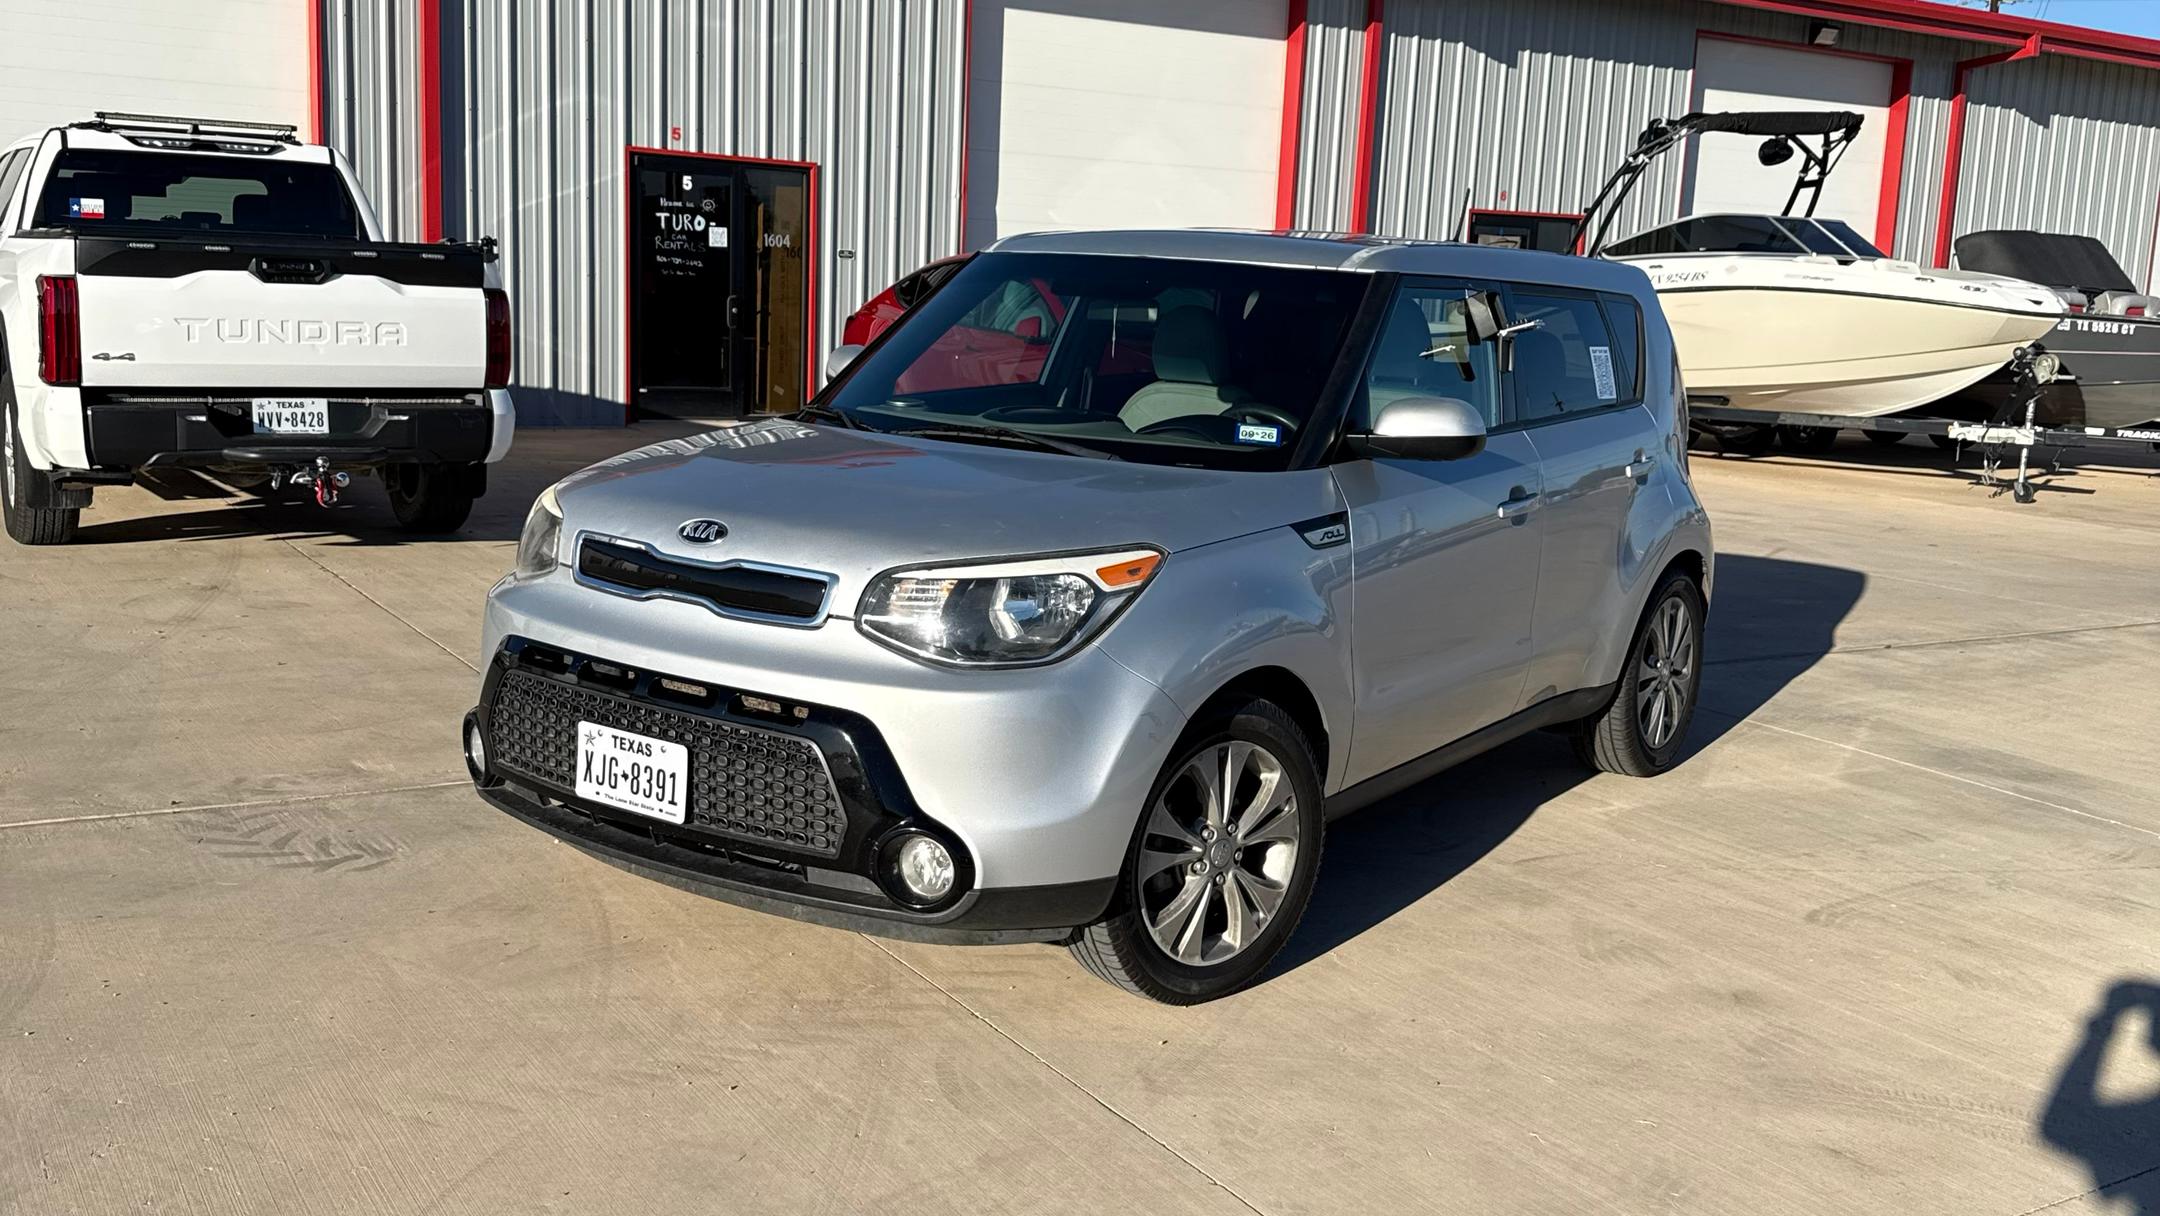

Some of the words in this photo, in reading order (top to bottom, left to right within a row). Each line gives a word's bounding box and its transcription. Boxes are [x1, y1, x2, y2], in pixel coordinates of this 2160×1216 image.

[671, 127, 681, 141] 5
[682, 175, 693, 190] 5
[655, 212, 706, 231] TURO
[655, 235, 706, 252] RENTALS
[764, 233, 790, 248] 1604
[173, 317, 408, 346] TUNDRA
[276, 401, 305, 409] TEXAS
[683, 522, 718, 540] KIA
[611, 735, 652, 757] TEXAS
[583, 749, 619, 790] XJG
[630, 762, 677, 806] 8391
